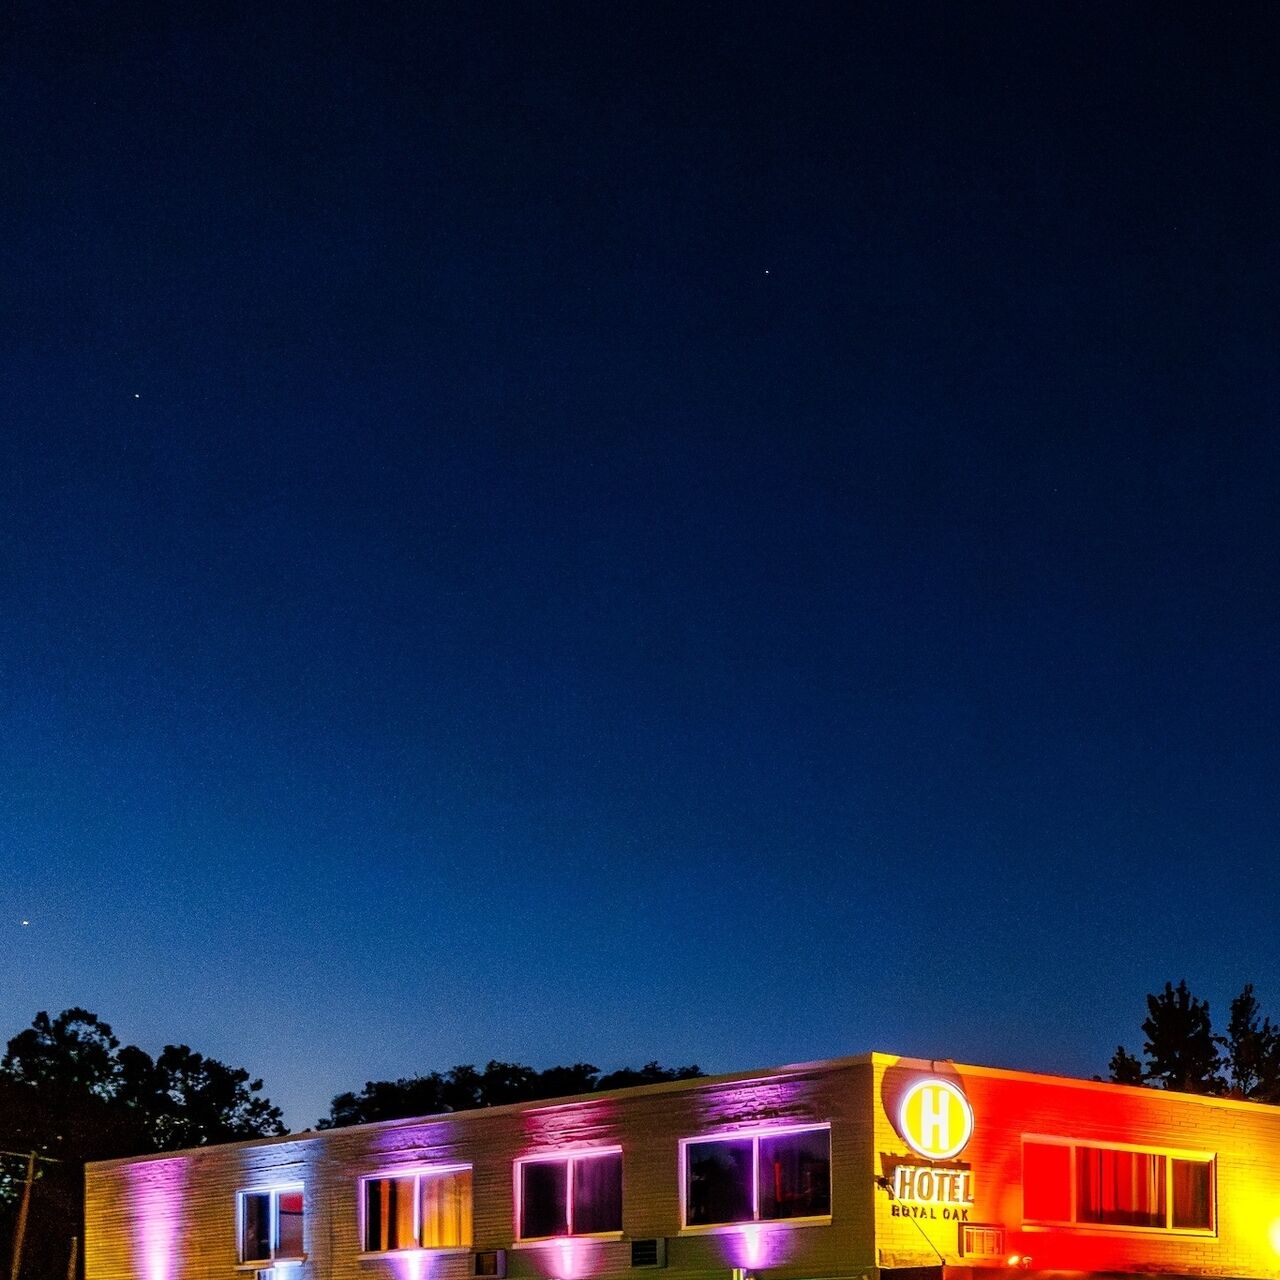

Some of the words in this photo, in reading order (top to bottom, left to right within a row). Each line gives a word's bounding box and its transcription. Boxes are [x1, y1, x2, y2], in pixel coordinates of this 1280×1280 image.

[921, 1087, 950, 1150] H
[898, 1168, 975, 1204] HOTEL
[891, 1204, 937, 1220] ROYAL
[942, 1207, 969, 1221] OAK
